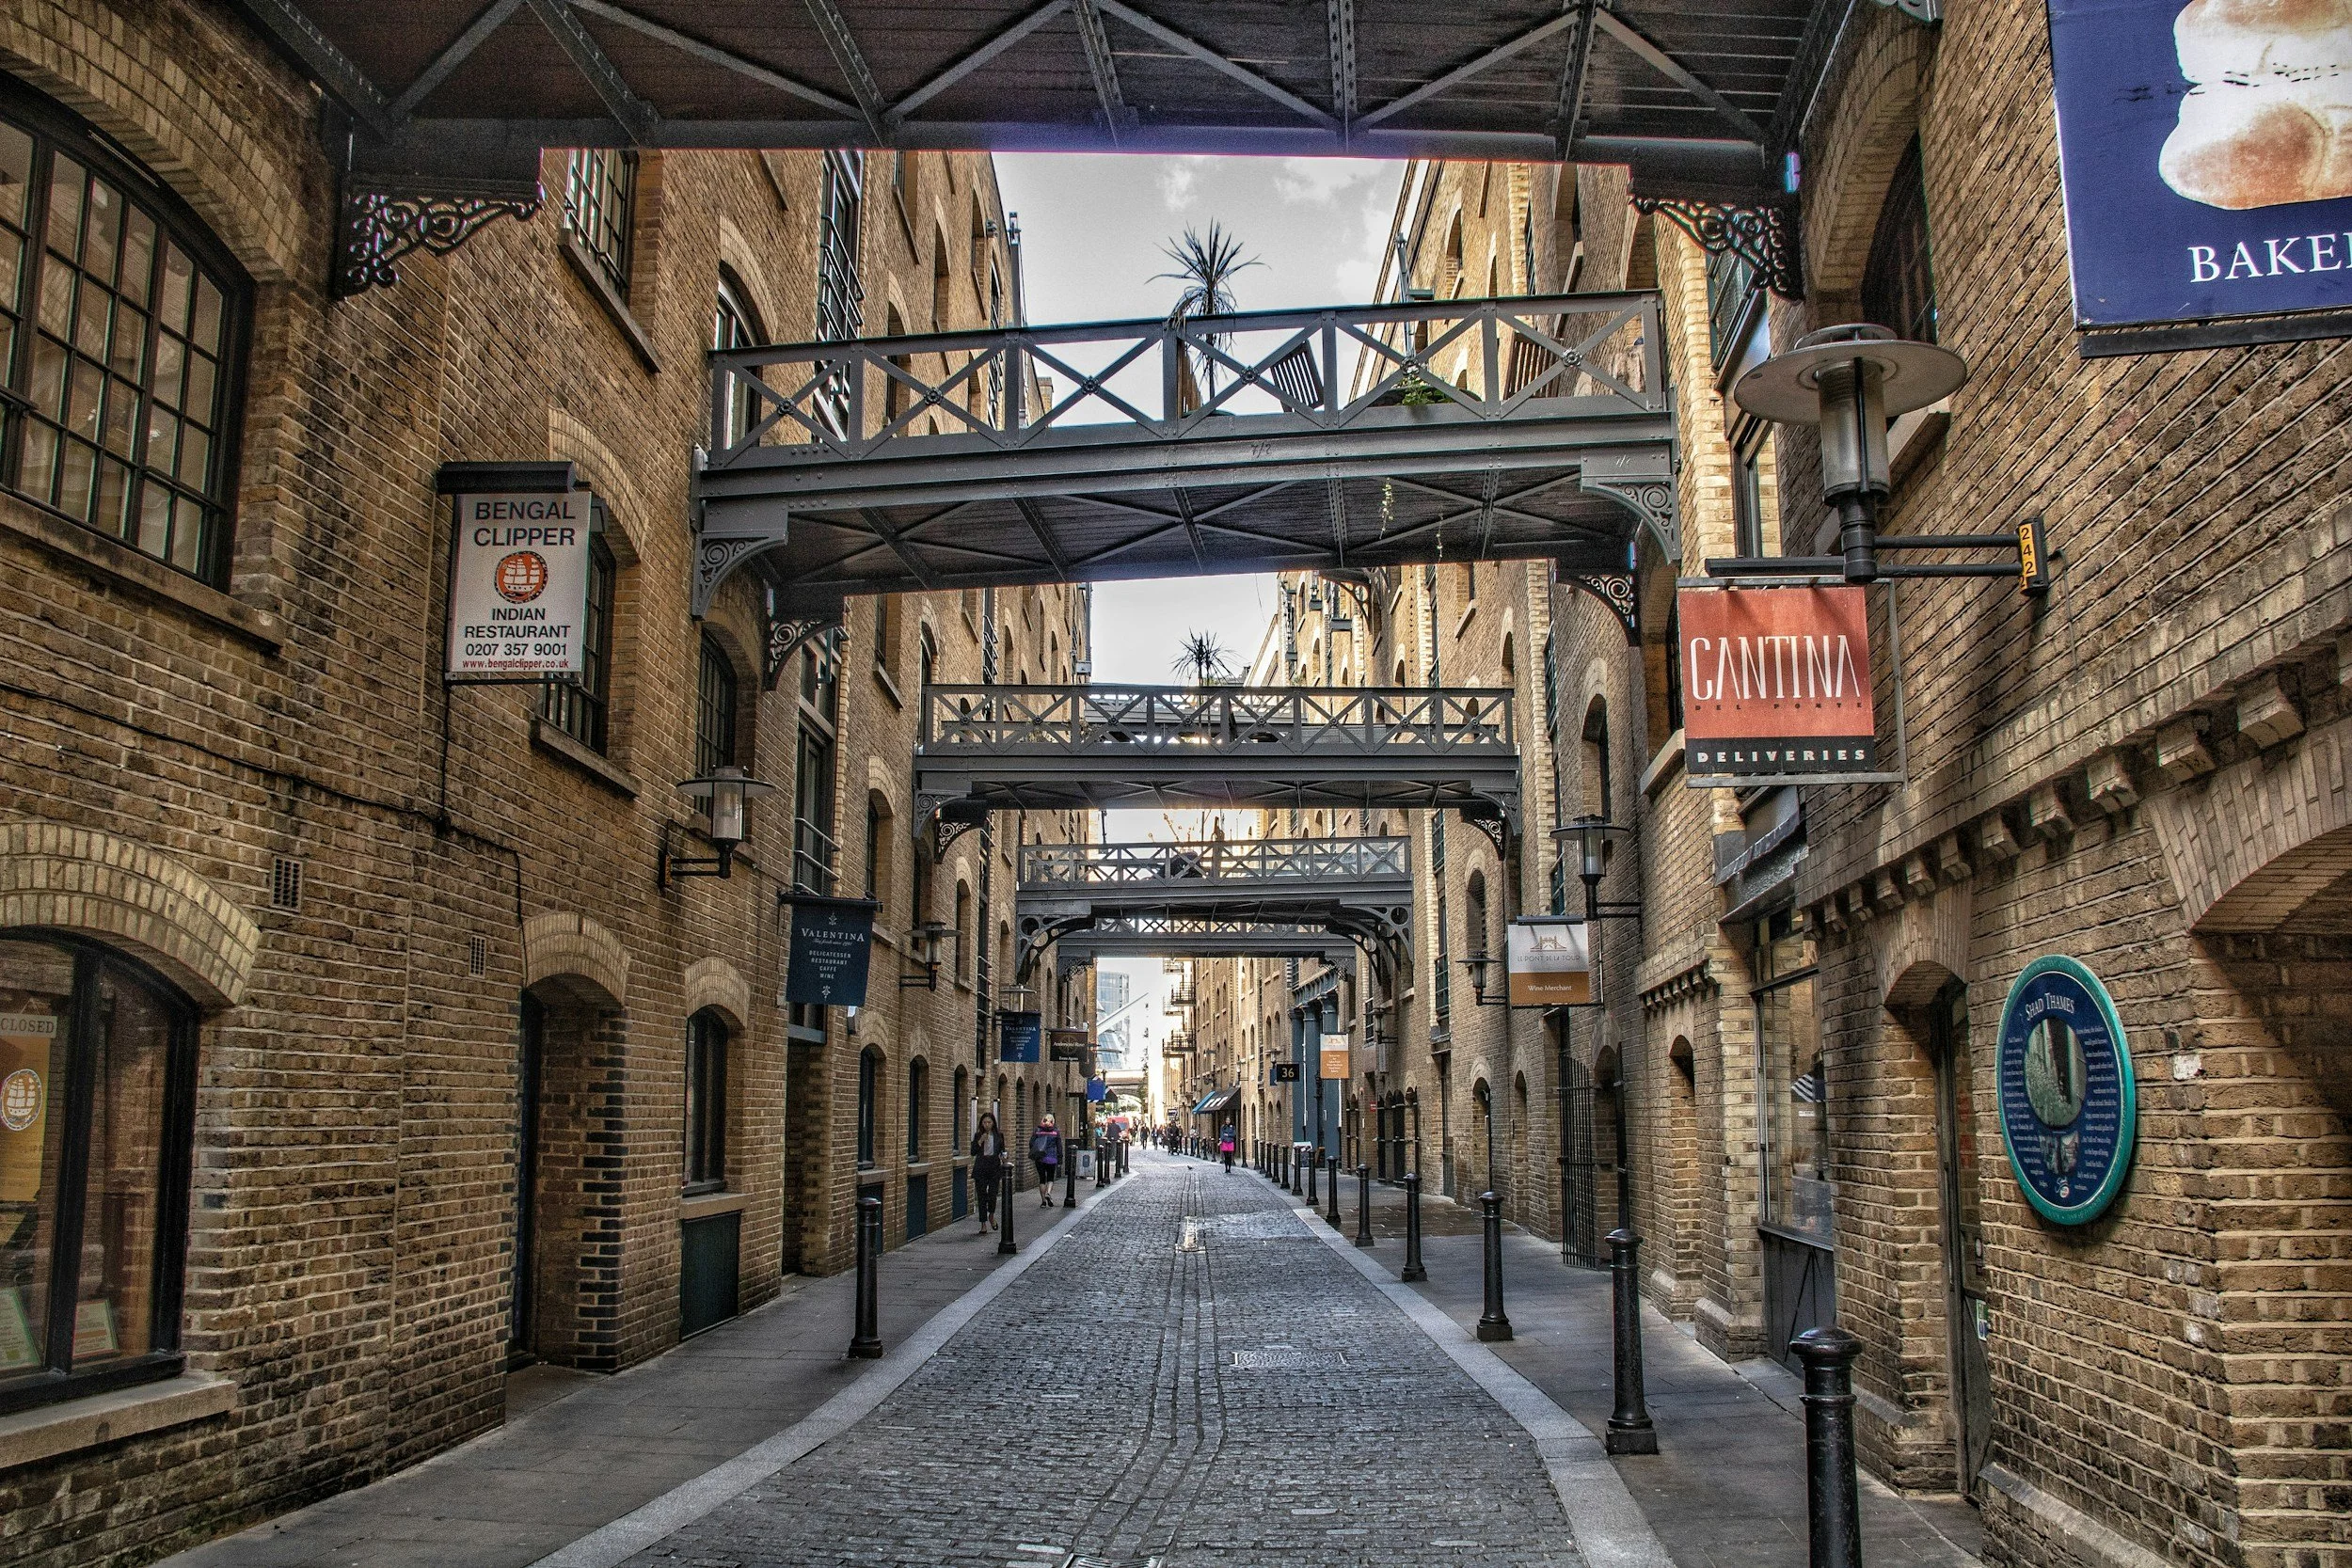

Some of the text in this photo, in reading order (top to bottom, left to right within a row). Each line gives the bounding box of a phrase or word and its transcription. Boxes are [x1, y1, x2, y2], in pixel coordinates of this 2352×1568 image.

[2187, 231, 2352, 283] BAKE
[475, 501, 576, 520] BENGAL
[473, 528, 575, 546] CLIPPER
[491, 608, 546, 621] INDIAN
[464, 626, 571, 639] RESTAURANT
[466, 642, 567, 656] 0207 357 9001
[462, 658, 569, 671] www.bengalclipper.co.uk
[1690, 635, 1861, 701] CANTINA
[1697, 750, 1865, 763] DELIVERIES
[802, 927, 865, 942] VALENTINA
[809, 950, 850, 958] DELICATESSEN
[1, 1018, 55, 1034] CLOSED
[1281, 1068, 1295, 1078] 36
